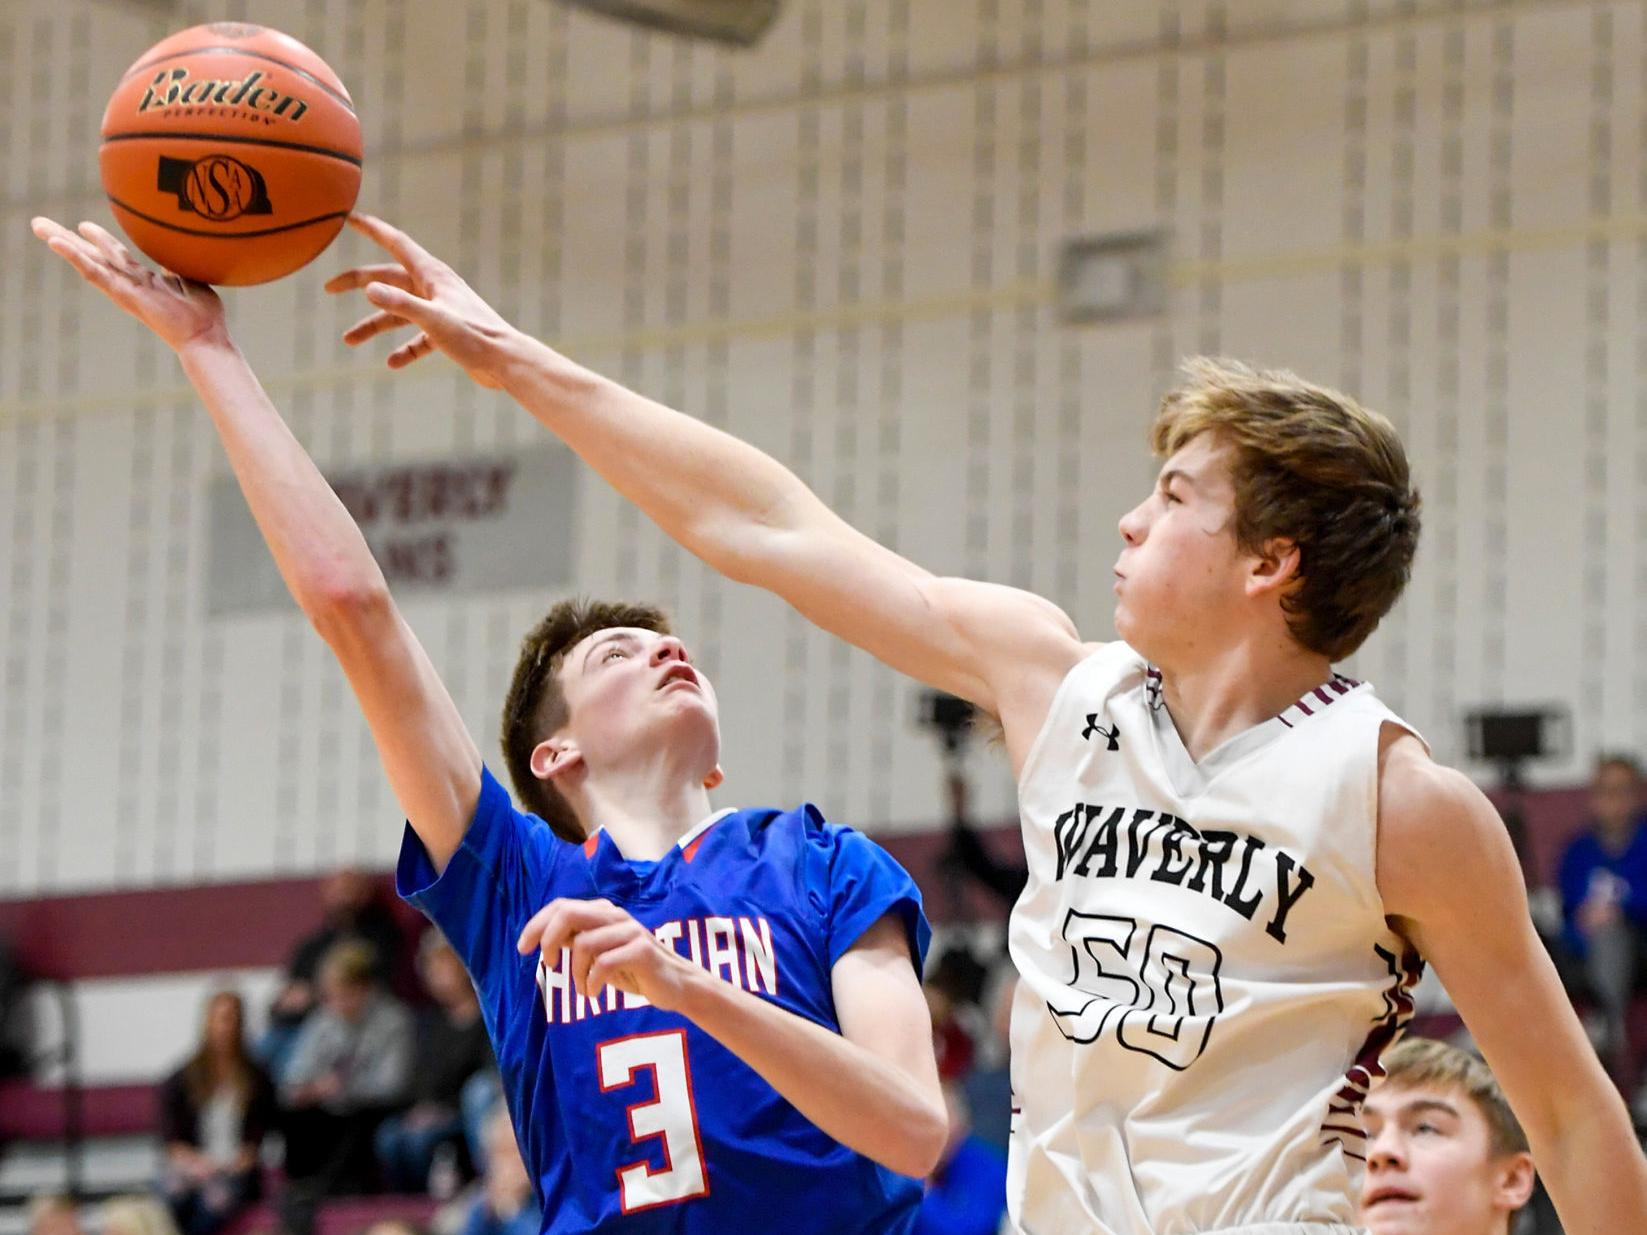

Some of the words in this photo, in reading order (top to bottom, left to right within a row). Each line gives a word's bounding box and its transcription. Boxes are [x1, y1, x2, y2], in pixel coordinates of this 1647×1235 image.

[138, 68, 308, 121] Baden
[1054, 802, 1315, 945] WAVERLY
[1047, 908, 1224, 1072] 50
[596, 1028, 711, 1216] 3
